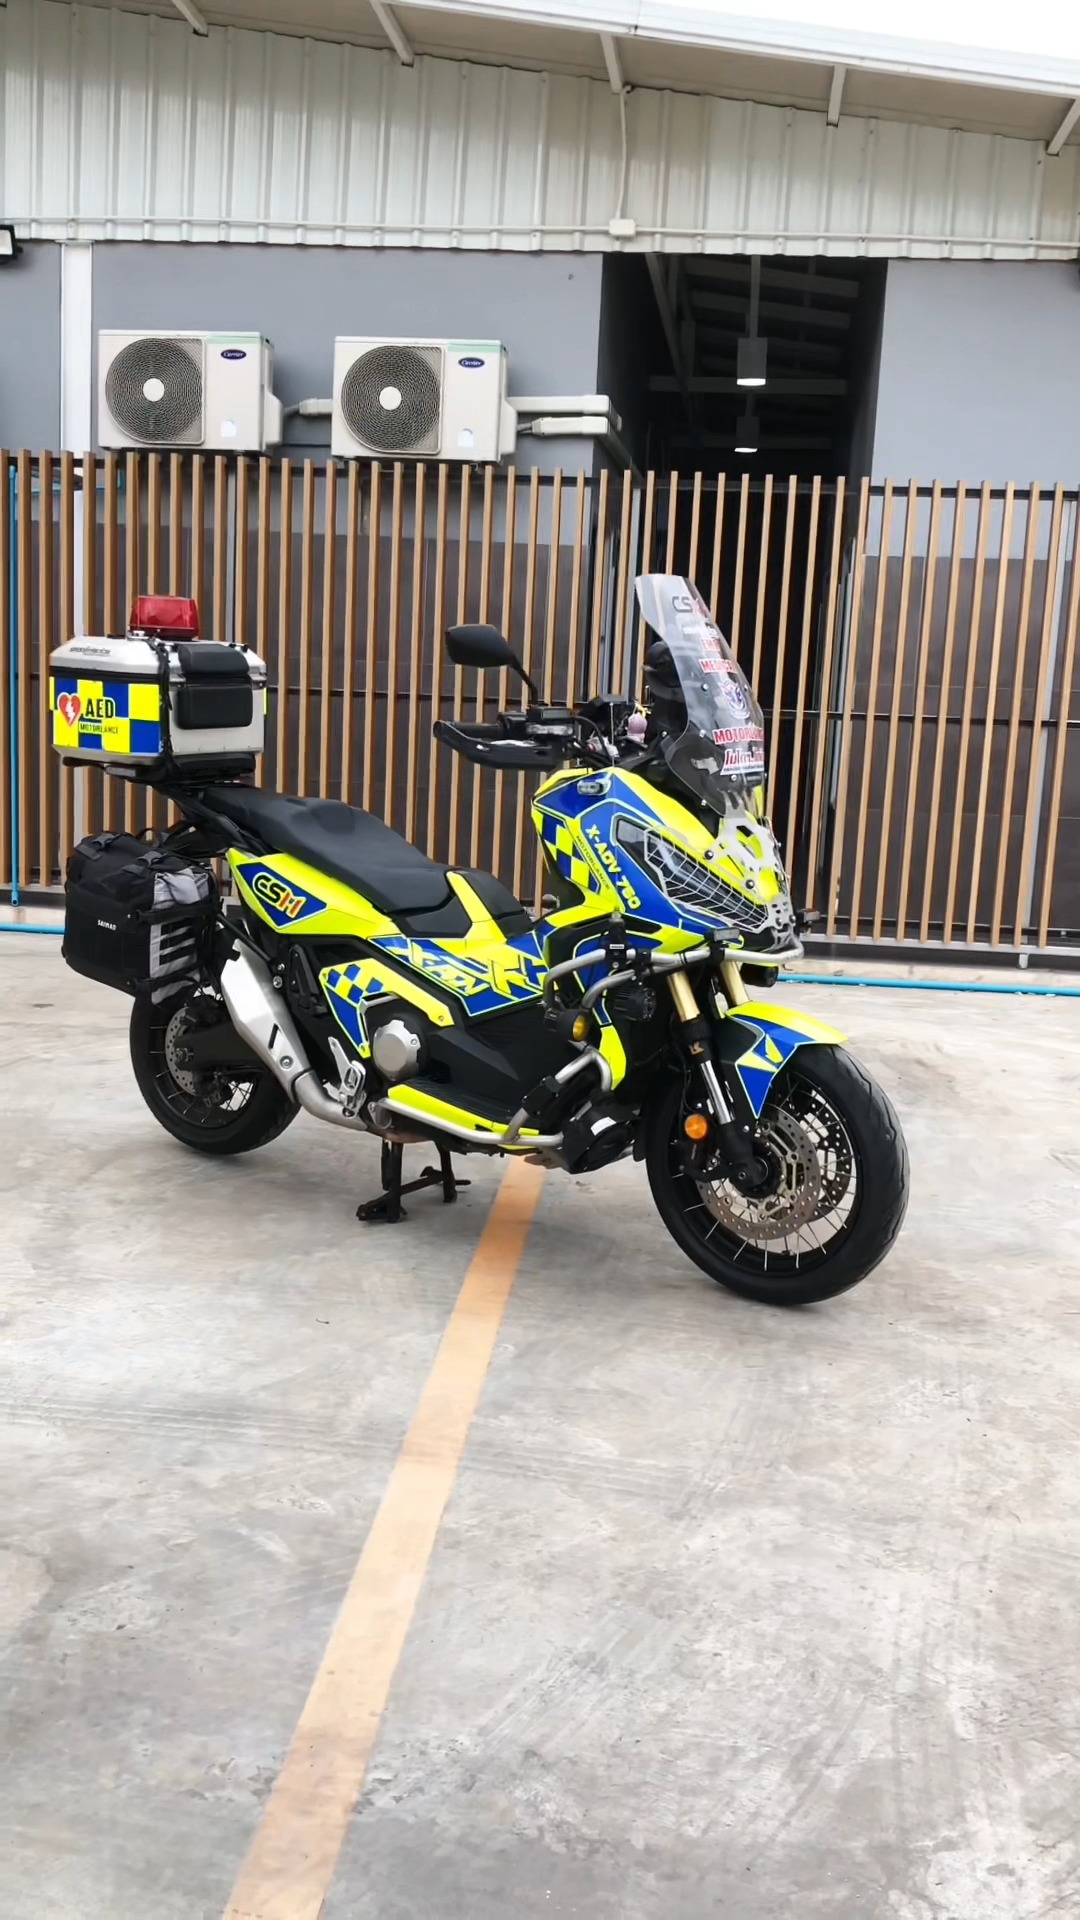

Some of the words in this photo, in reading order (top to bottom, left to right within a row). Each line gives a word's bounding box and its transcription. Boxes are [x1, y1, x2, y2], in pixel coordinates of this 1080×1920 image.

[85, 698, 114, 718] AED
[585, 824, 621, 873] X-ADV
[616, 875, 641, 910] 750
